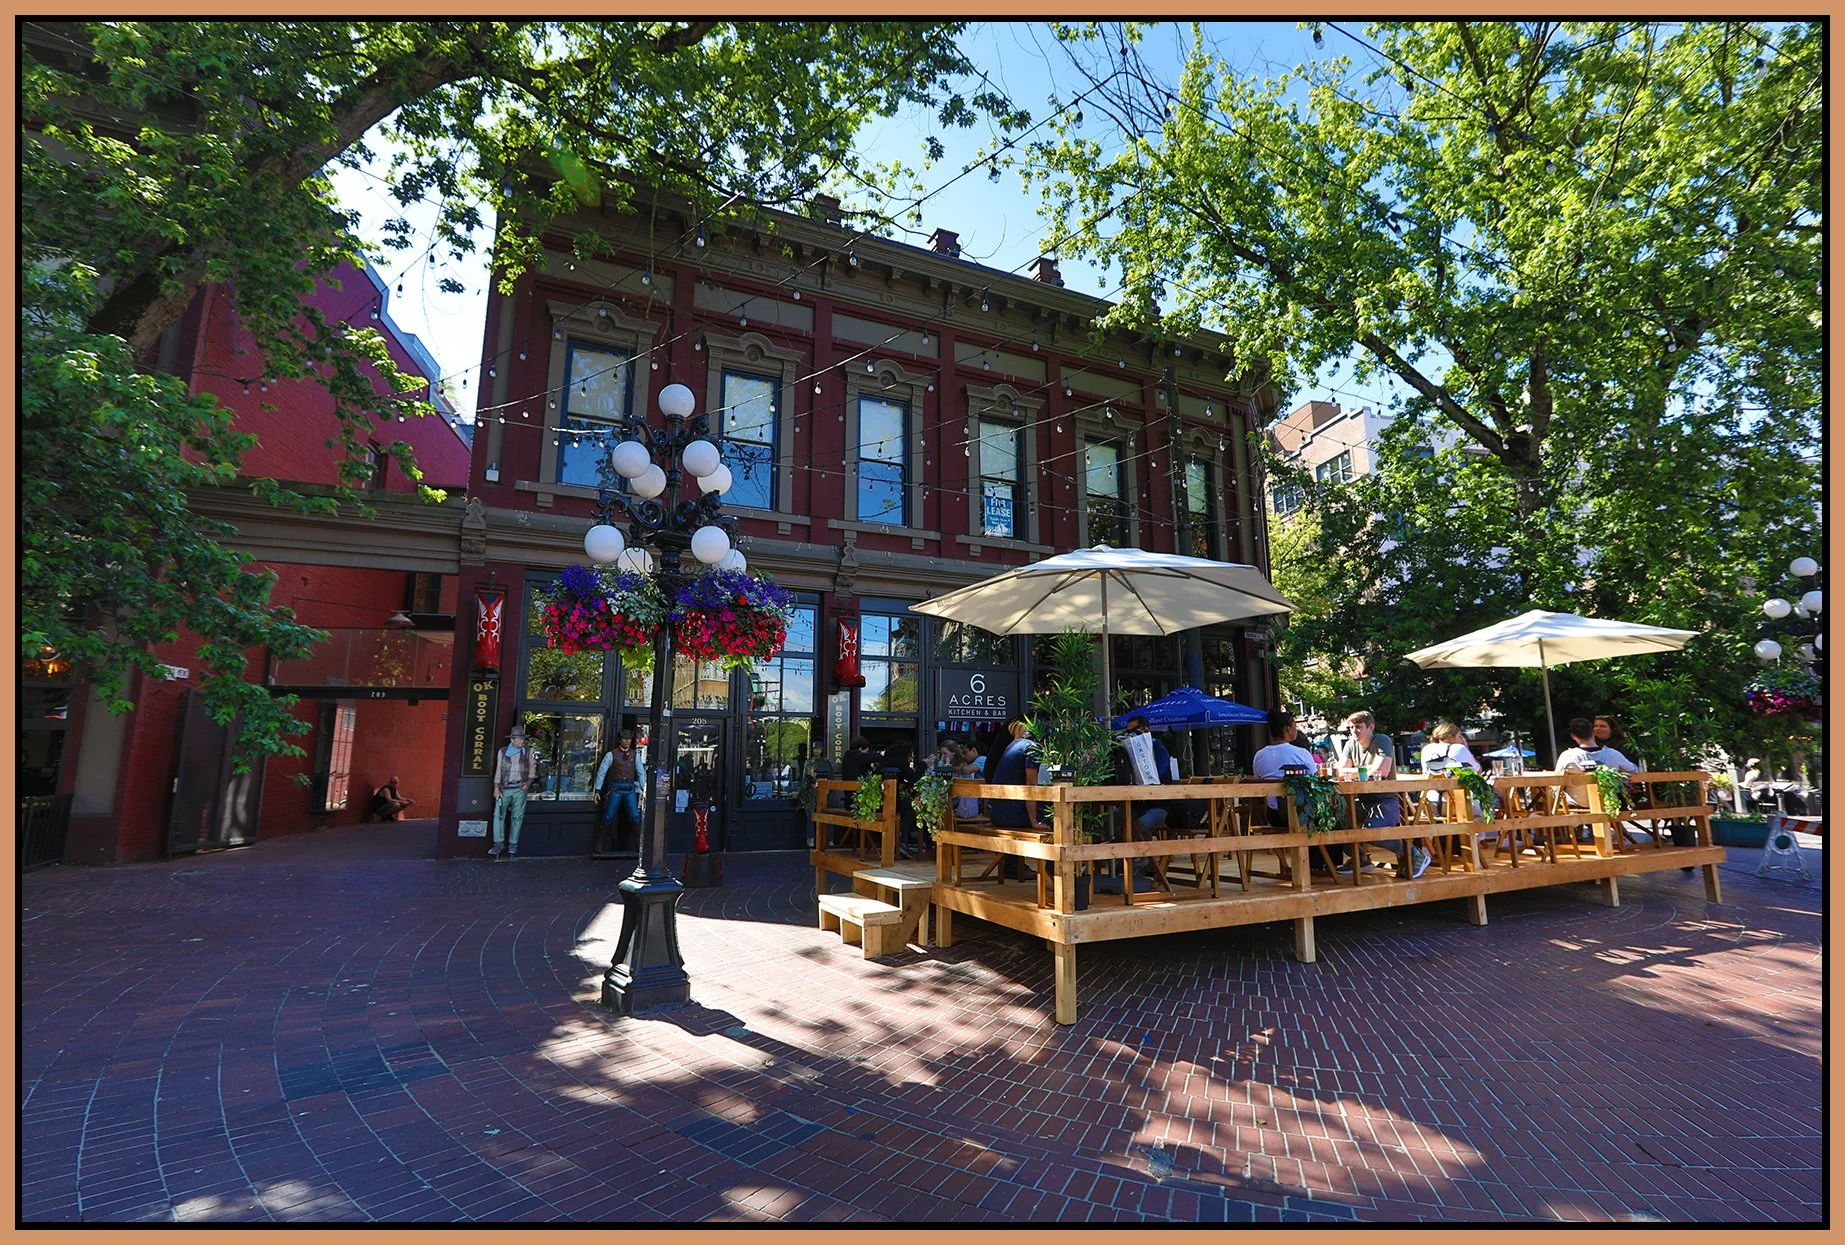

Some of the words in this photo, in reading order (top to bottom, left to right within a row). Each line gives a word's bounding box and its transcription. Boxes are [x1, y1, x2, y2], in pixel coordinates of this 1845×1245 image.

[986, 506, 1011, 517] LEASE
[473, 680, 494, 692] OK
[970, 673, 986, 694] 6
[831, 693, 847, 703] OK
[949, 694, 1007, 707] ACRES
[476, 694, 488, 722] BOOT
[949, 708, 981, 716] KITCHEN
[835, 705, 843, 729] BOOT
[472, 727, 485, 769] CORRAL
[835, 733, 843, 764] CORRA
